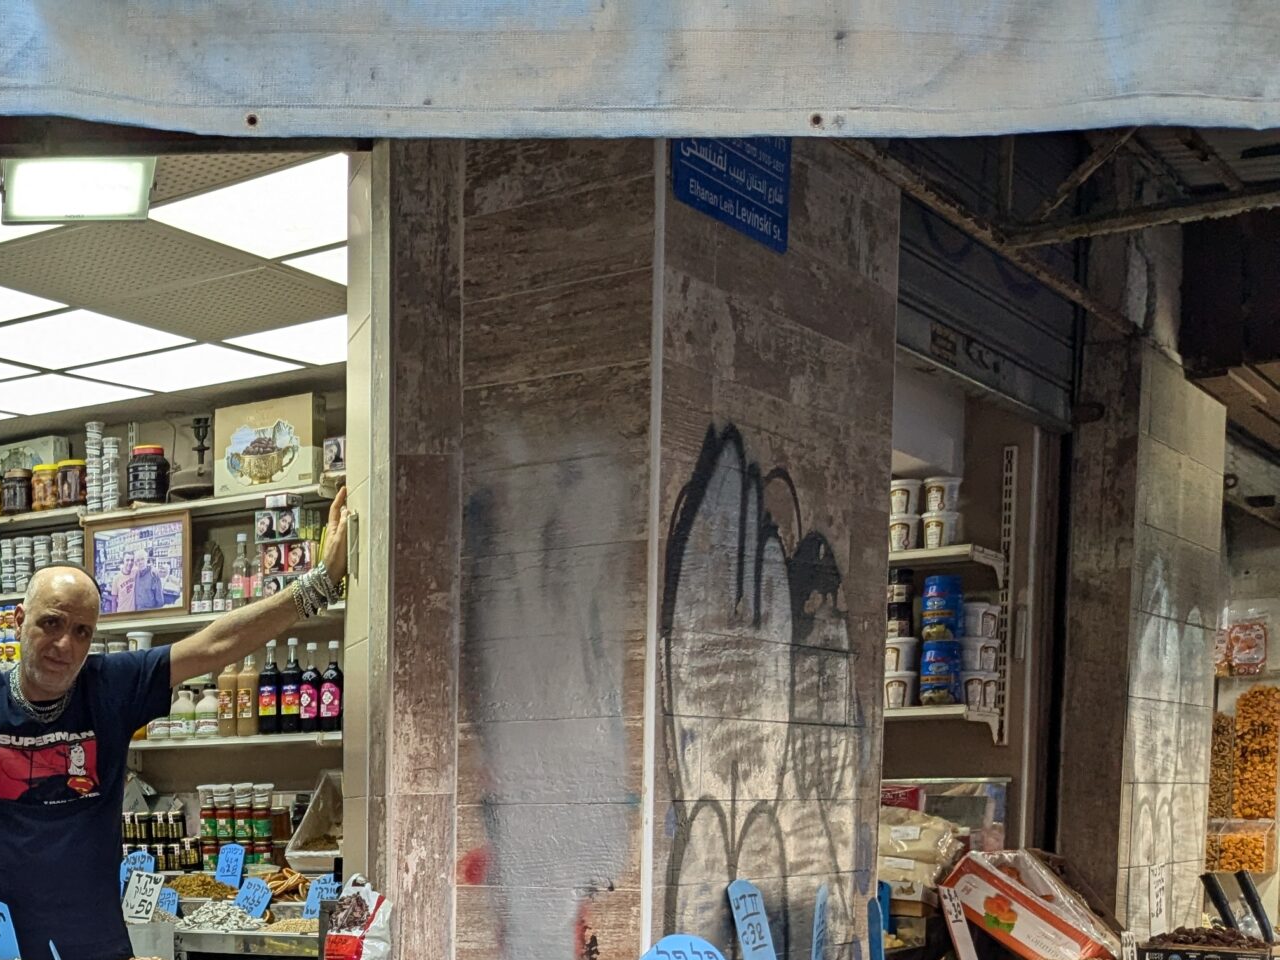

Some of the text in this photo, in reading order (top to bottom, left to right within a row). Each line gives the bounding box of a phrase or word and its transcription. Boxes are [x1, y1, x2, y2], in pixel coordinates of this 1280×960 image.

[735, 199, 772, 236] Levinski
[135, 872, 163, 890] שקד
[134, 899, 153, 915] 50
